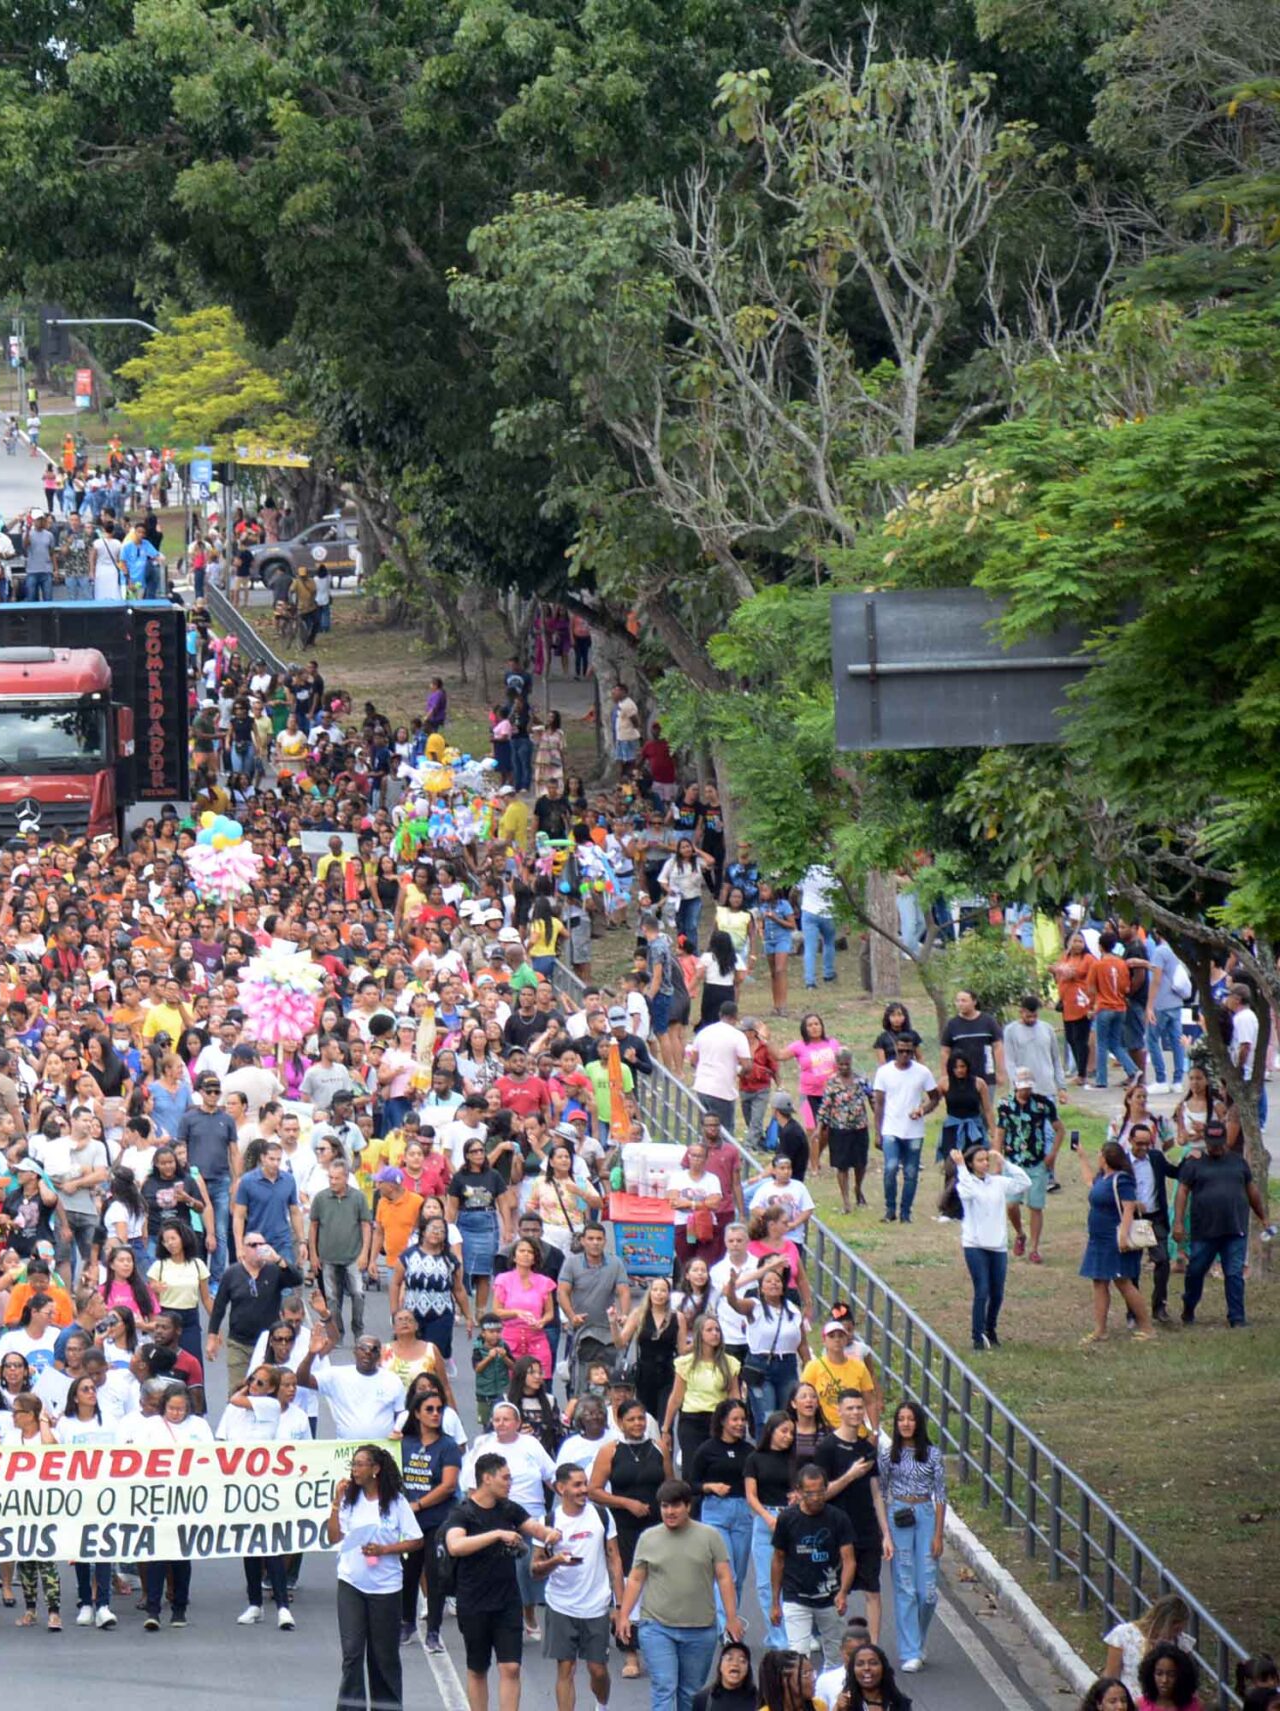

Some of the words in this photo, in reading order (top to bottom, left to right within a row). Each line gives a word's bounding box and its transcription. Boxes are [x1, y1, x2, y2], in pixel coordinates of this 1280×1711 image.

[144, 620, 165, 788] COMENDADOR
[97, 1487, 116, 1516] O
[130, 1484, 208, 1516] REINO
[224, 1483, 280, 1513] DOS
[79, 1516, 159, 1557] ESTÁ
